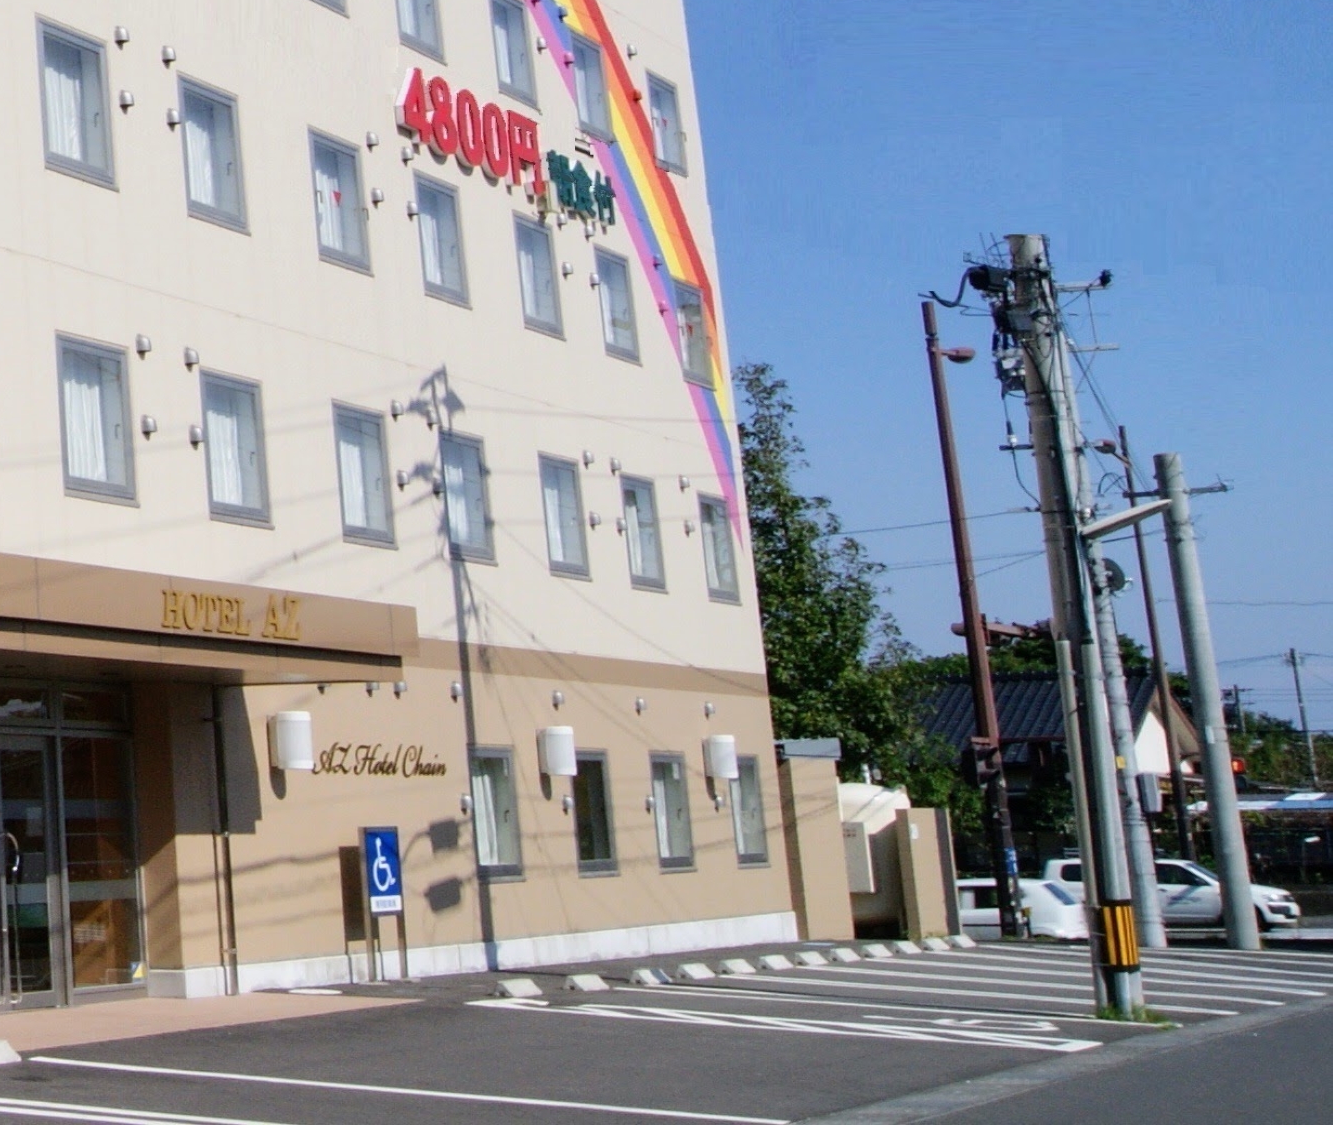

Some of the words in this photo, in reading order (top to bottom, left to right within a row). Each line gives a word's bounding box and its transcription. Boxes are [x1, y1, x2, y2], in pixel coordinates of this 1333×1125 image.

[397, 66, 547, 196] 4800円
[161, 588, 252, 636] HOTEL
[261, 593, 303, 641] AZ
[312, 741, 352, 775] AZ
[353, 742, 403, 776] Hotel
[402, 744, 447, 779] Chain
